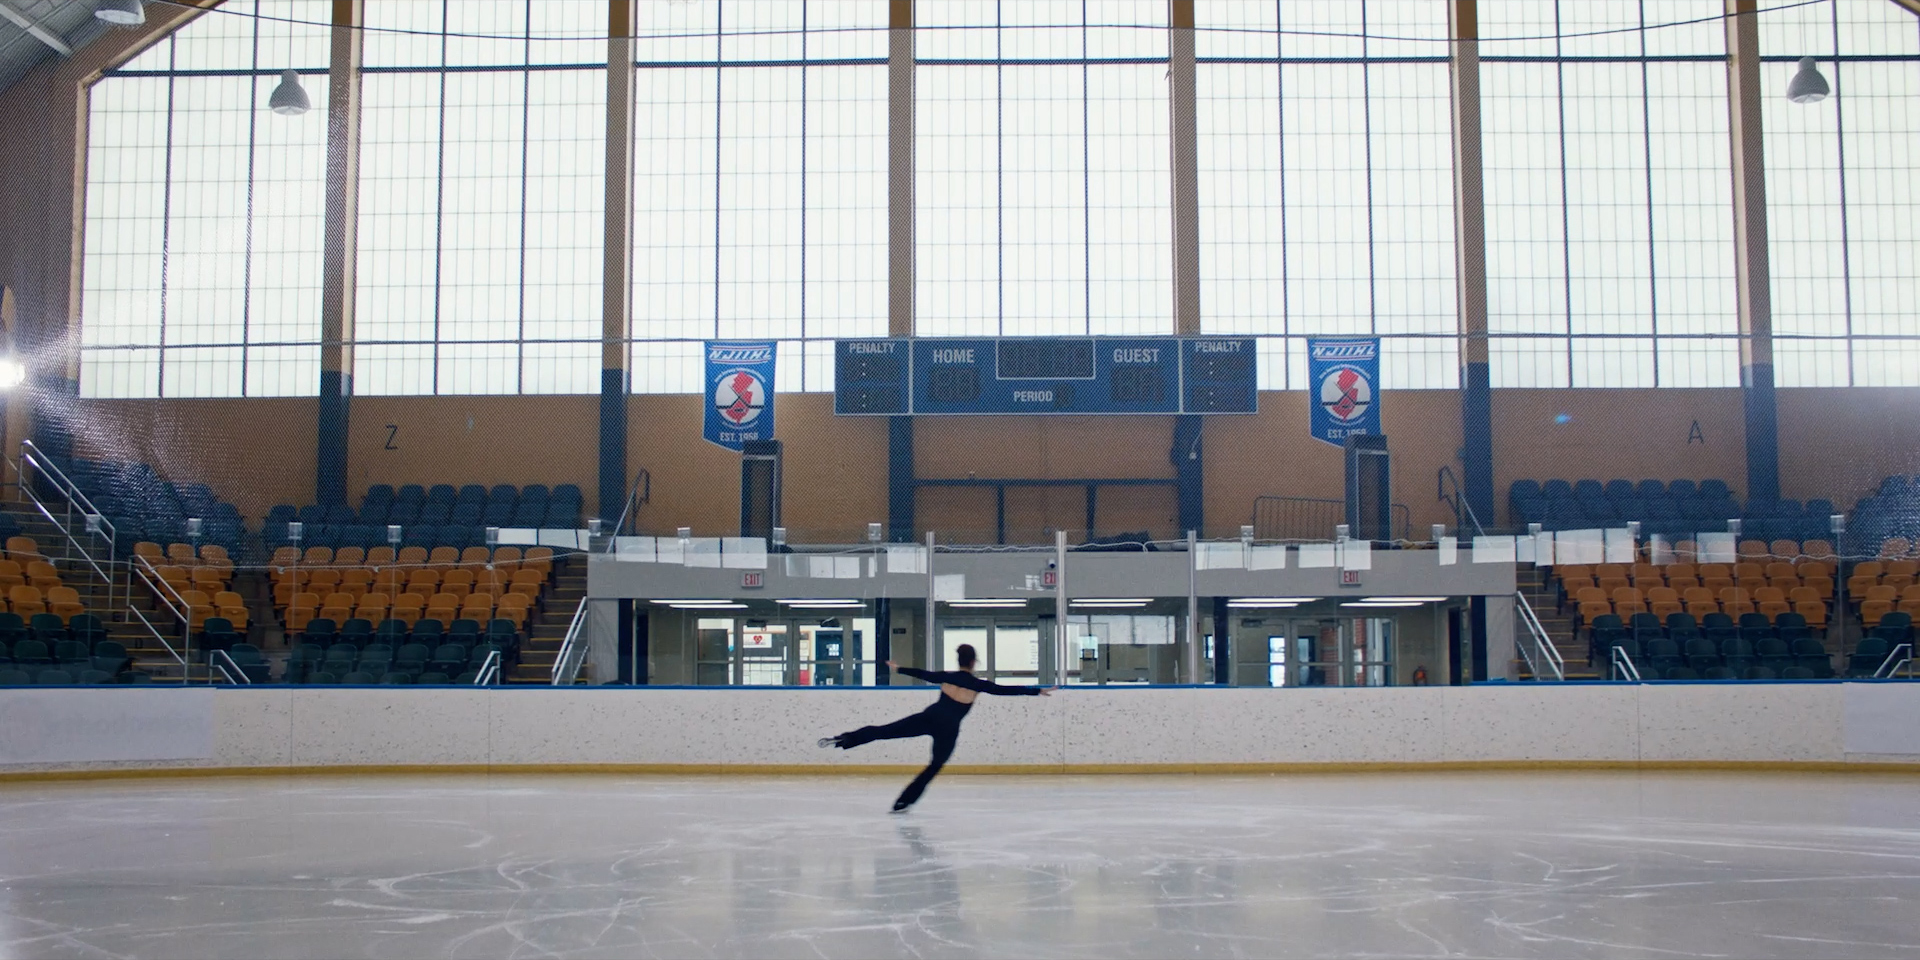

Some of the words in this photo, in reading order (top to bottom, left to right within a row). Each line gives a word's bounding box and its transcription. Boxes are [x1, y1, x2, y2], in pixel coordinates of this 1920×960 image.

[848, 342, 896, 354] PENALTY
[1195, 341, 1242, 353] PENALTY
[933, 349, 975, 364] HOME
[1113, 348, 1160, 364] GUEST
[1013, 390, 1053, 402] PERIOD
[384, 424, 398, 450] Z
[1687, 419, 1705, 445] A
[744, 572, 761, 585] EXIT
[1044, 572, 1056, 584] EXI
[1343, 571, 1359, 583] EXIT
